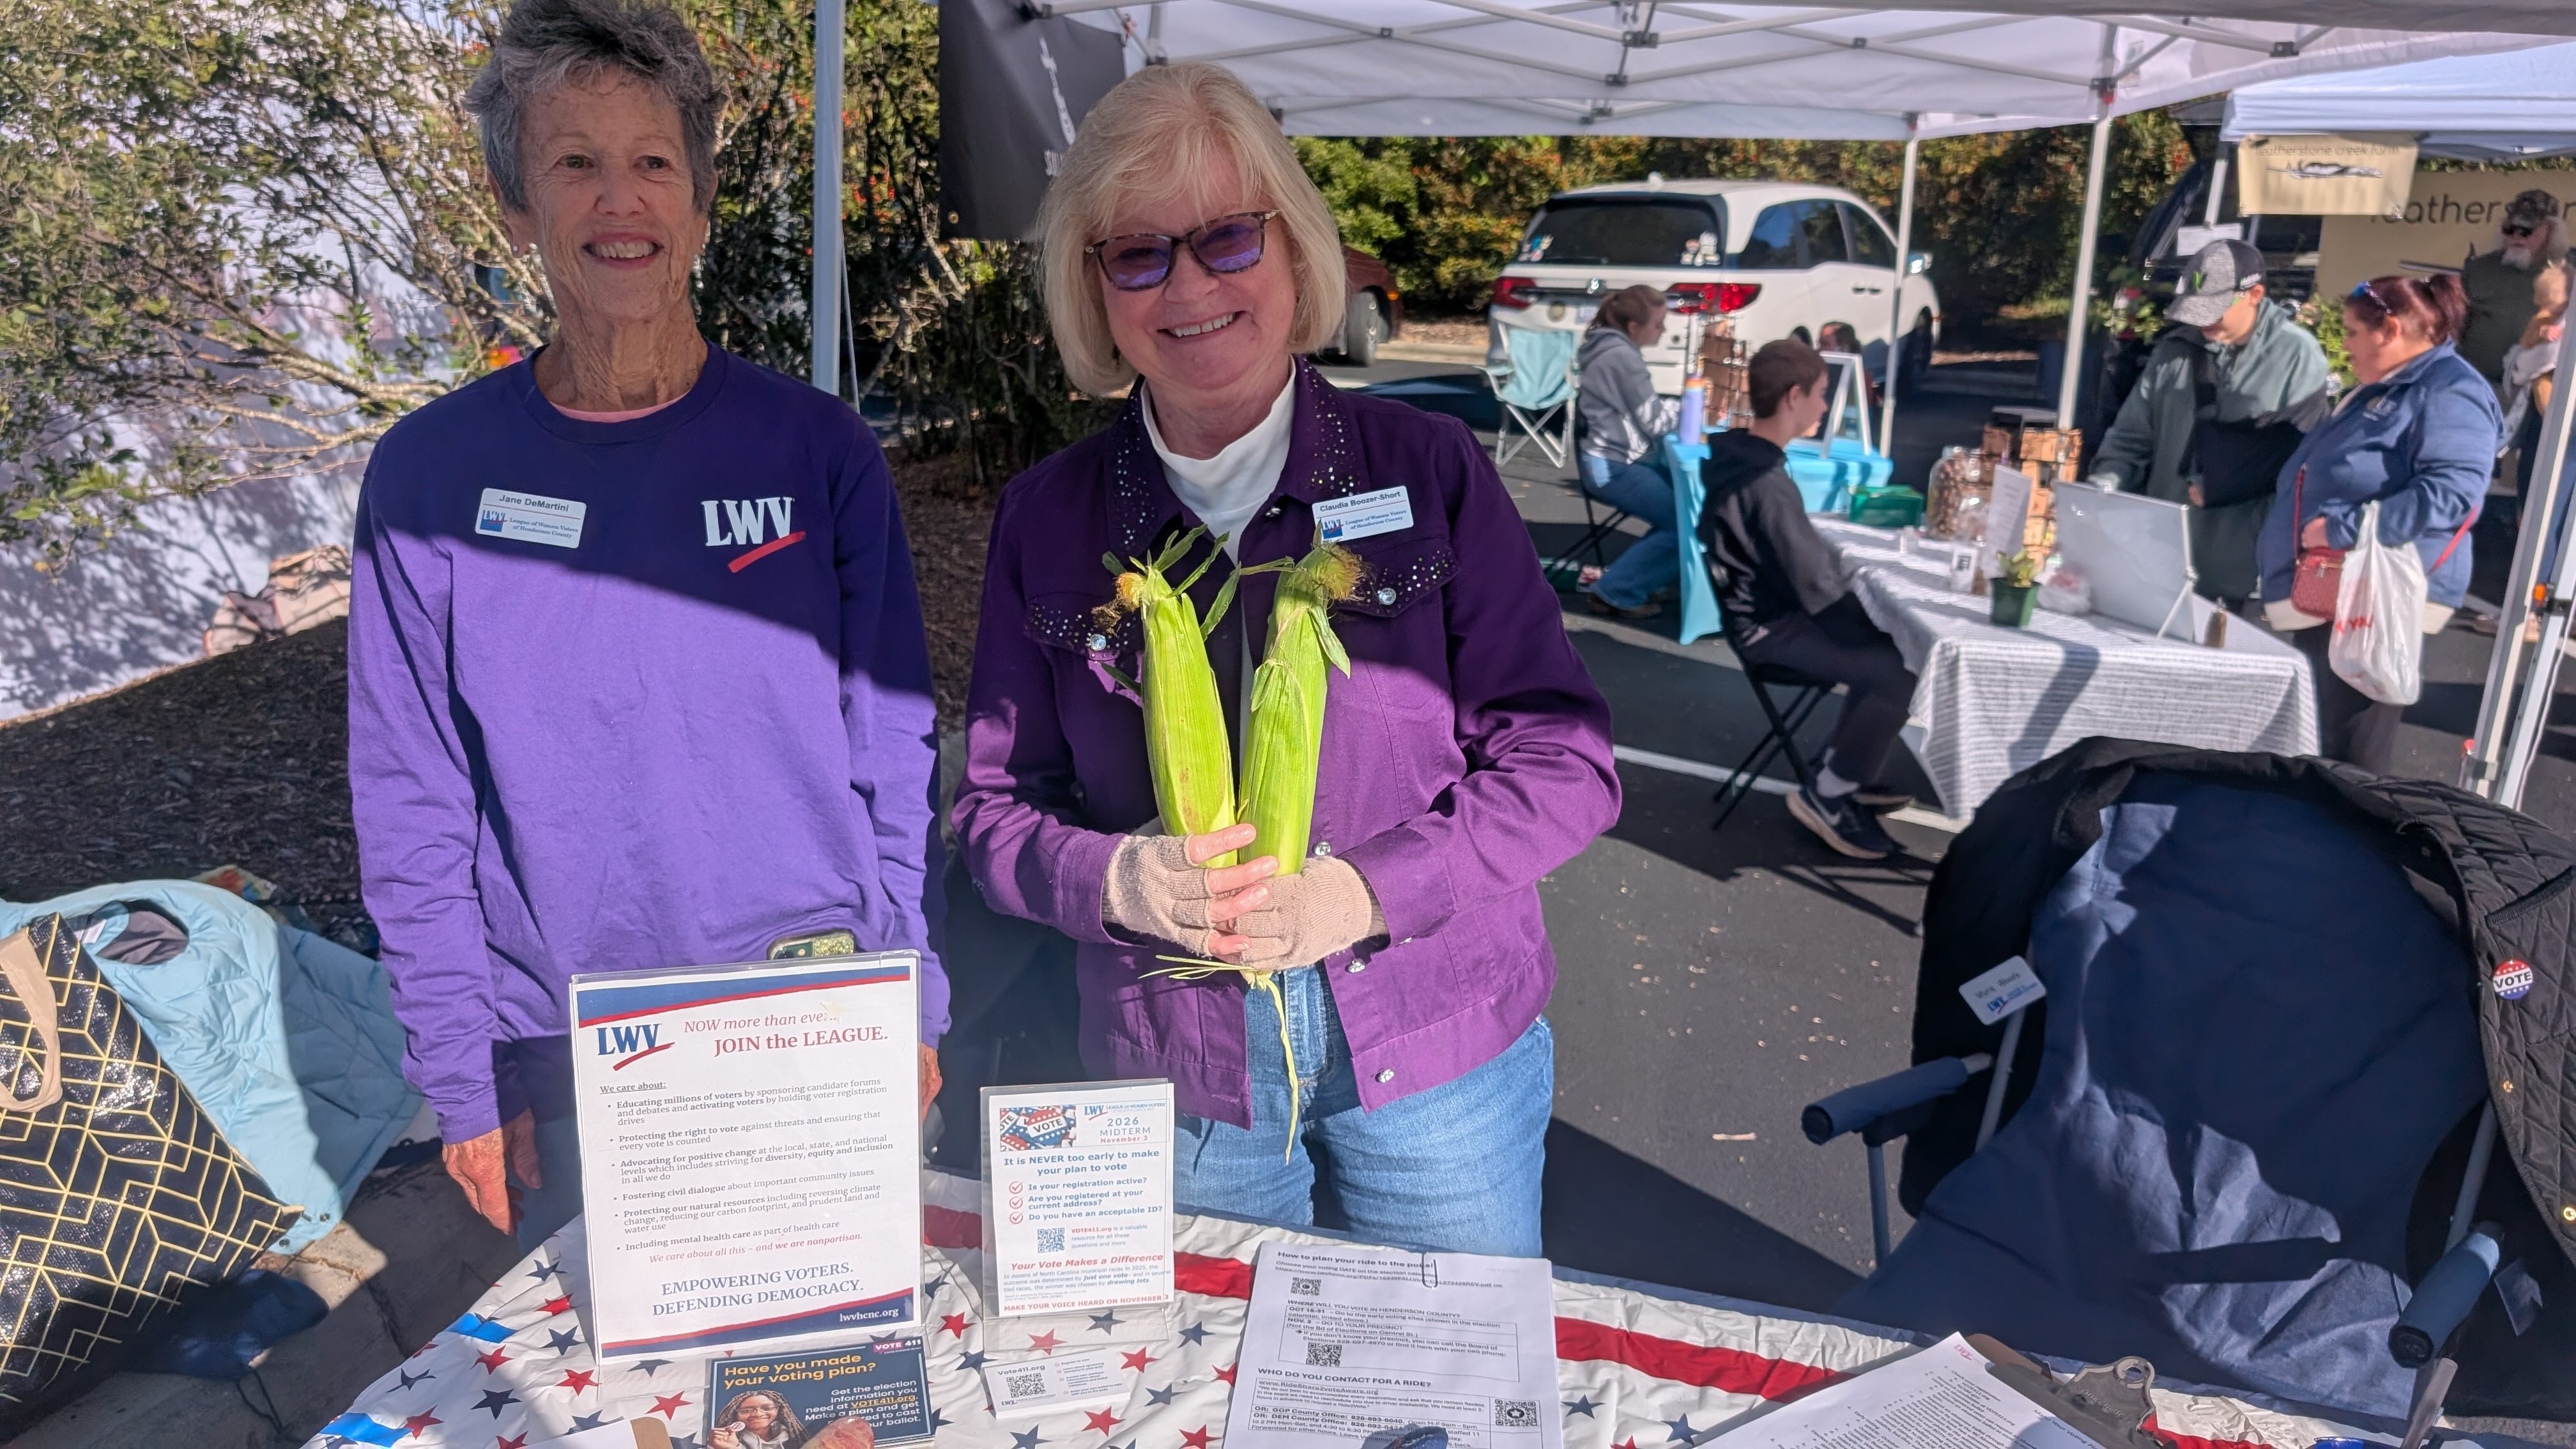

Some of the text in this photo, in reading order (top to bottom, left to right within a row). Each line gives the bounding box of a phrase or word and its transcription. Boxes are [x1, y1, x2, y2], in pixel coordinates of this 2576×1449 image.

[2335, 145, 2366, 155] creek
[2371, 146, 2399, 155] farm
[499, 494, 569, 511] Jane DeMartini
[1319, 491, 1400, 512] Claudia Boozer-Short
[509, 518, 530, 526] League
[702, 497, 793, 546] LWV
[1356, 519, 1384, 528] Henderson
[1384, 516, 1403, 524] County
[519, 526, 551, 534] Henderson
[551, 530, 572, 538] County
[2493, 971, 2532, 989] VOTE
[684, 1018, 721, 1032] NOW
[724, 1018, 760, 1030] more
[764, 1013, 796, 1027] than
[597, 1023, 660, 1056] LWV
[714, 1026, 887, 1054] JOIN the LEAGUE.
[601, 1084, 616, 1093] We
[638, 1081, 666, 1091] about:
[617, 1077, 881, 1110] Educating millions of voters by sponsoring candidate forums
[1084, 1105, 1104, 1116] LWV
[1033, 1118, 1062, 1133] VOTE
[1107, 1117, 1138, 1126] 2026
[1100, 1126, 1151, 1137] MIDTERM
[1100, 1135, 1140, 1144] November
[1029, 1154, 1064, 1164] NEVER
[1068, 1153, 1084, 1162] too
[1087, 1152, 1114, 1162] early
[1131, 1149, 1159, 1158] make
[1064, 1165, 1086, 1174] plan
[622, 1168, 875, 1202] Fostering civil dialogue about important community issues
[1062, 1179, 1114, 1190] registration
[1116, 1177, 1147, 1185] active?
[1065, 1191, 1109, 1201] registered
[1062, 1199, 1102, 1208] address?
[1098, 1207, 1145, 1217] acceptable
[1011, 1262, 1036, 1270] Your
[1038, 1260, 1062, 1268] Vote
[1064, 1257, 1098, 1267] Makes
[1110, 1253, 1164, 1264] Difference
[661, 1262, 854, 1295] EMPOWERING VOTERS.
[652, 1280, 863, 1315] DEFENDING DEMOCRACY.
[1120, 1294, 1162, 1303] NOVEMBER
[839, 1307, 900, 1324] lwvhcnc.org
[875, 1338, 921, 1351] VOTE 411
[724, 1353, 861, 1376] Have you made
[998, 1364, 1046, 1376] Vote411.org
[724, 1363, 877, 1388] your voting plan?
[1324, 1374, 1370, 1383] CONTACT
[831, 1379, 916, 1395] Get the election
[830, 1388, 917, 1403] information you
[806, 1404, 834, 1414] need
[850, 1393, 918, 1410] VOTE411.org.
[896, 1409, 921, 1418] cast
[887, 1416, 921, 1426] ballot.
